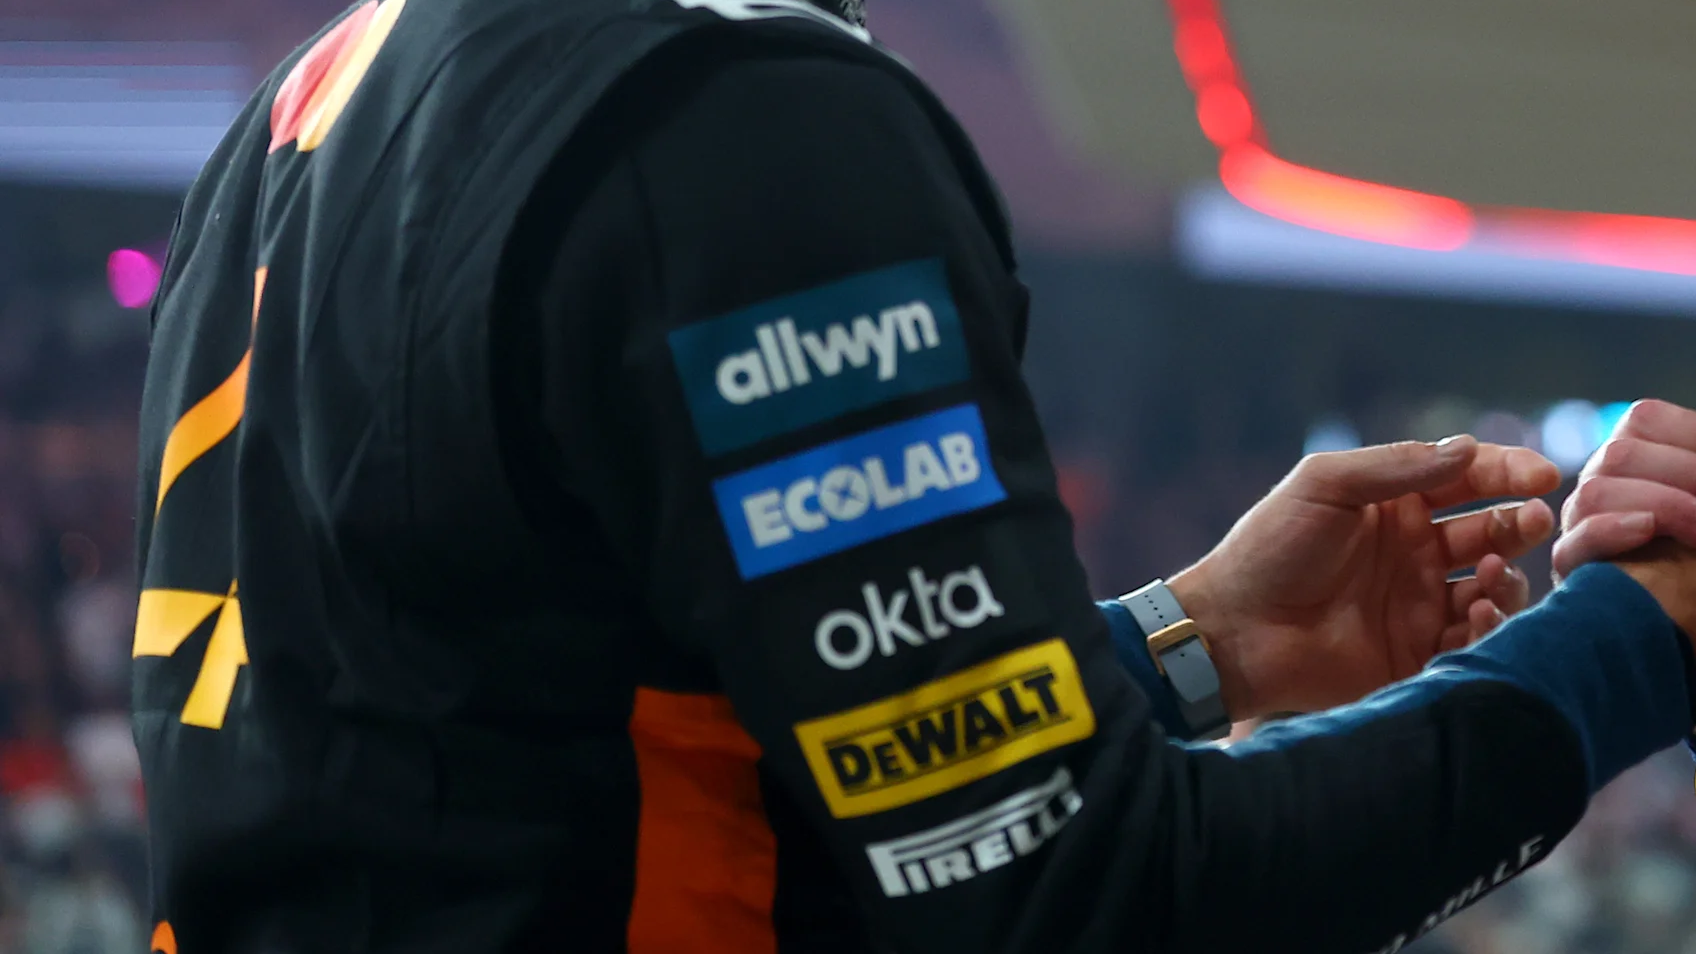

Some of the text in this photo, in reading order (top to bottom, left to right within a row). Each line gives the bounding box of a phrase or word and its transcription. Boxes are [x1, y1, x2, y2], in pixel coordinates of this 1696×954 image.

[715, 299, 941, 405] allwyn
[741, 431, 981, 551] ECOLAB
[813, 564, 1005, 670] okta
